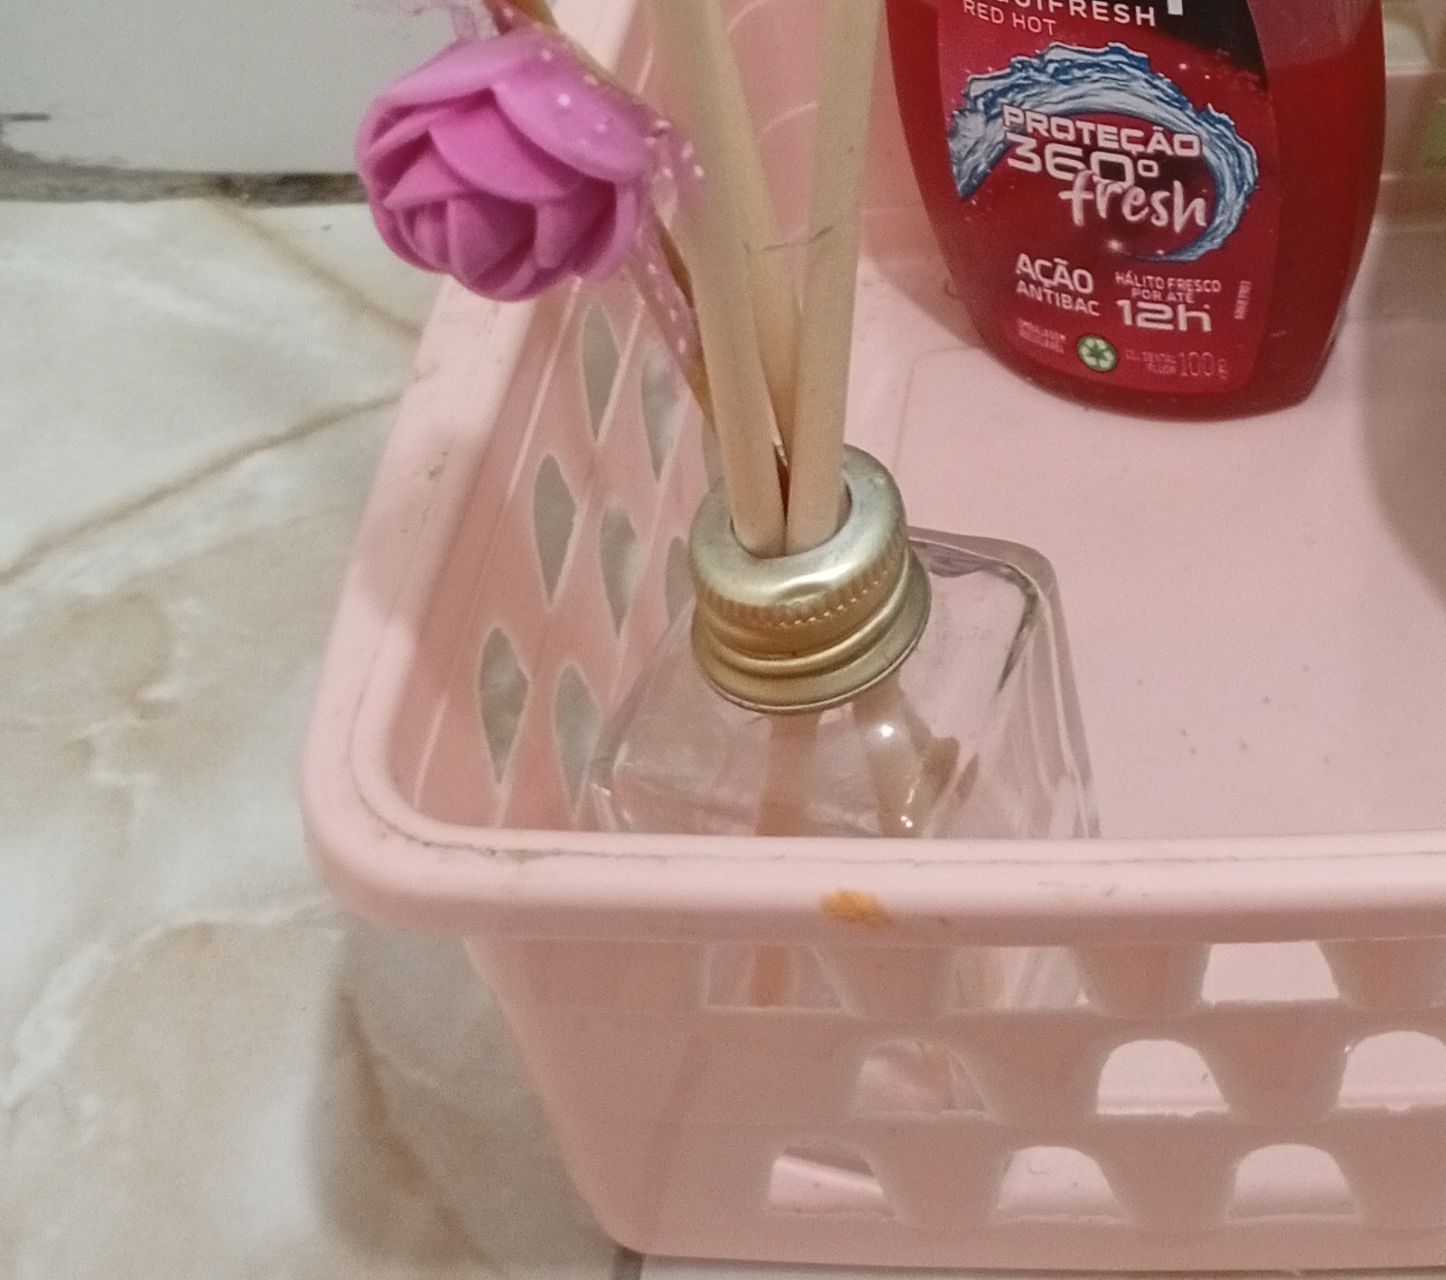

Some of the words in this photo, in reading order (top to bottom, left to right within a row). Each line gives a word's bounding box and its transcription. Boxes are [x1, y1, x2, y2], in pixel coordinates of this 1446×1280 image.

[1012, 13, 1058, 36] HOT
[1002, 104, 1202, 157] PROTEÇÃO
[1058, 170, 1207, 233] fresh
[1015, 252, 1094, 295] AÇÃO
[1015, 279, 1101, 318] ANTIBAC
[1116, 298, 1213, 332] 12h
